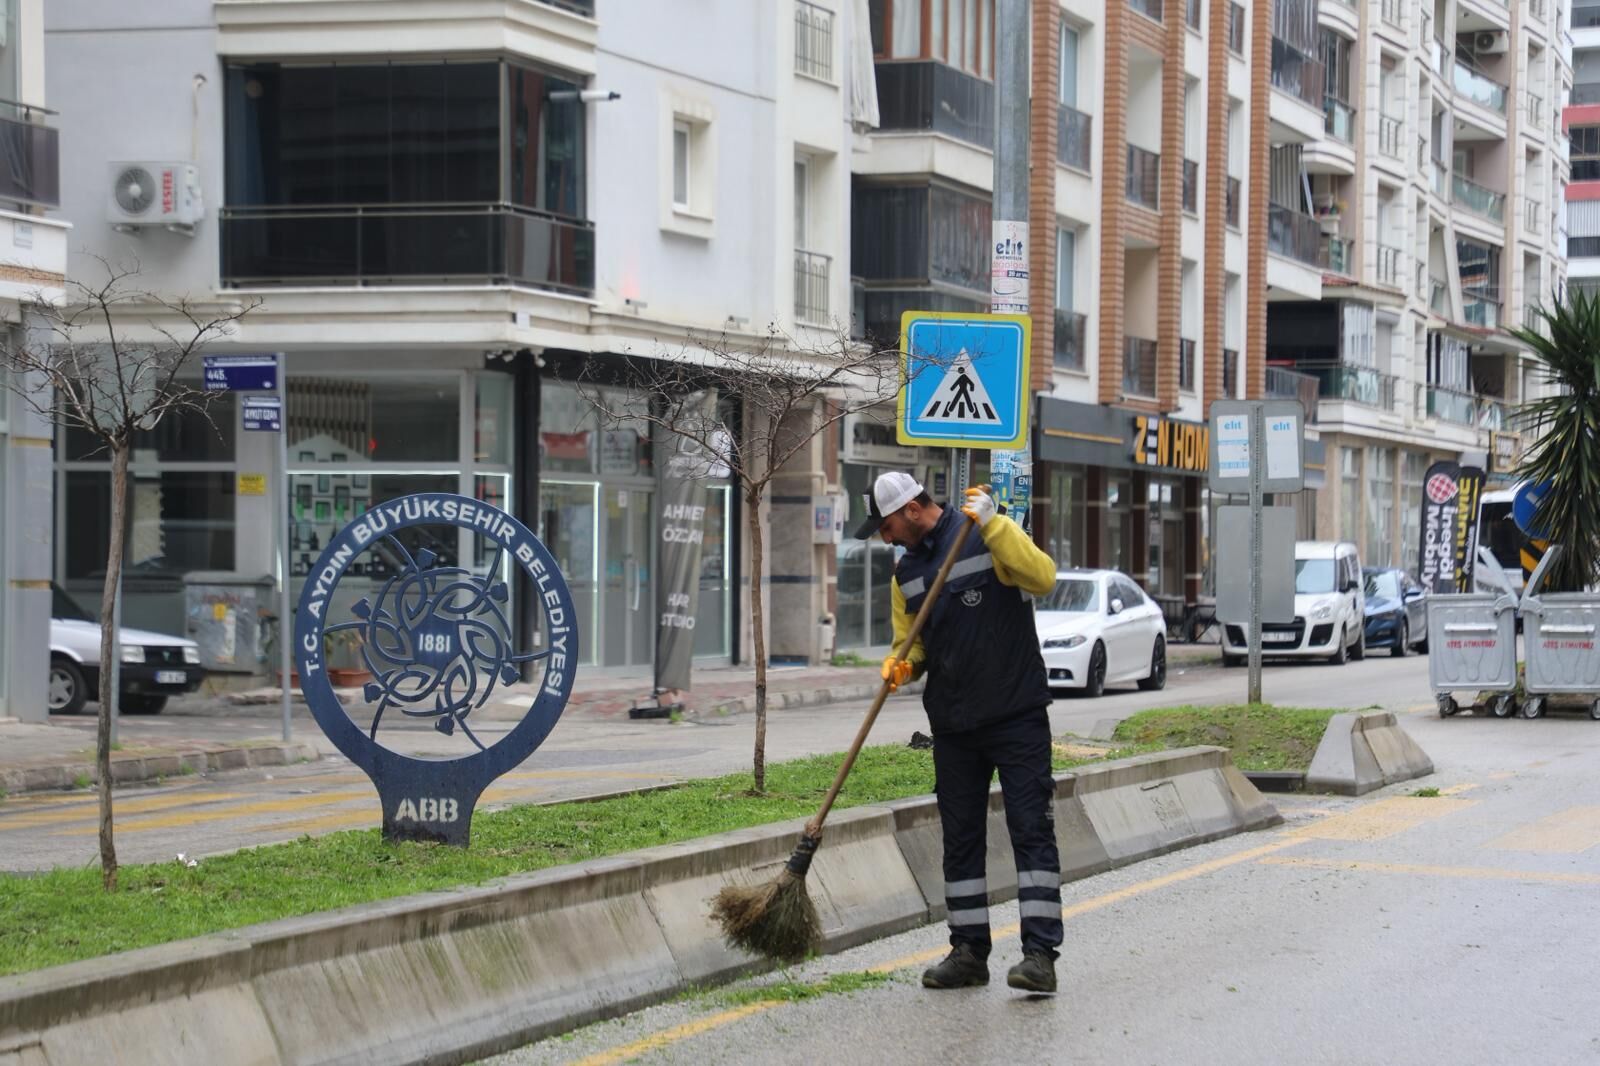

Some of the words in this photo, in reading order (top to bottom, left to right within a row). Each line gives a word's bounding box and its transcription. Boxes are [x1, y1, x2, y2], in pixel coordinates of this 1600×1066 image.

[1135, 415, 1170, 468] ZEN
[1173, 421, 1209, 472] HOM
[1224, 421, 1242, 430] elit
[1272, 421, 1291, 431] elit
[352, 496, 516, 546] BÜYÜKŞEHİR
[308, 543, 354, 619] AYDIN
[418, 633, 451, 652] 1881
[515, 542, 570, 698] BELEDİYESİ
[303, 626, 320, 677] T.C.
[395, 797, 458, 823] ABB
